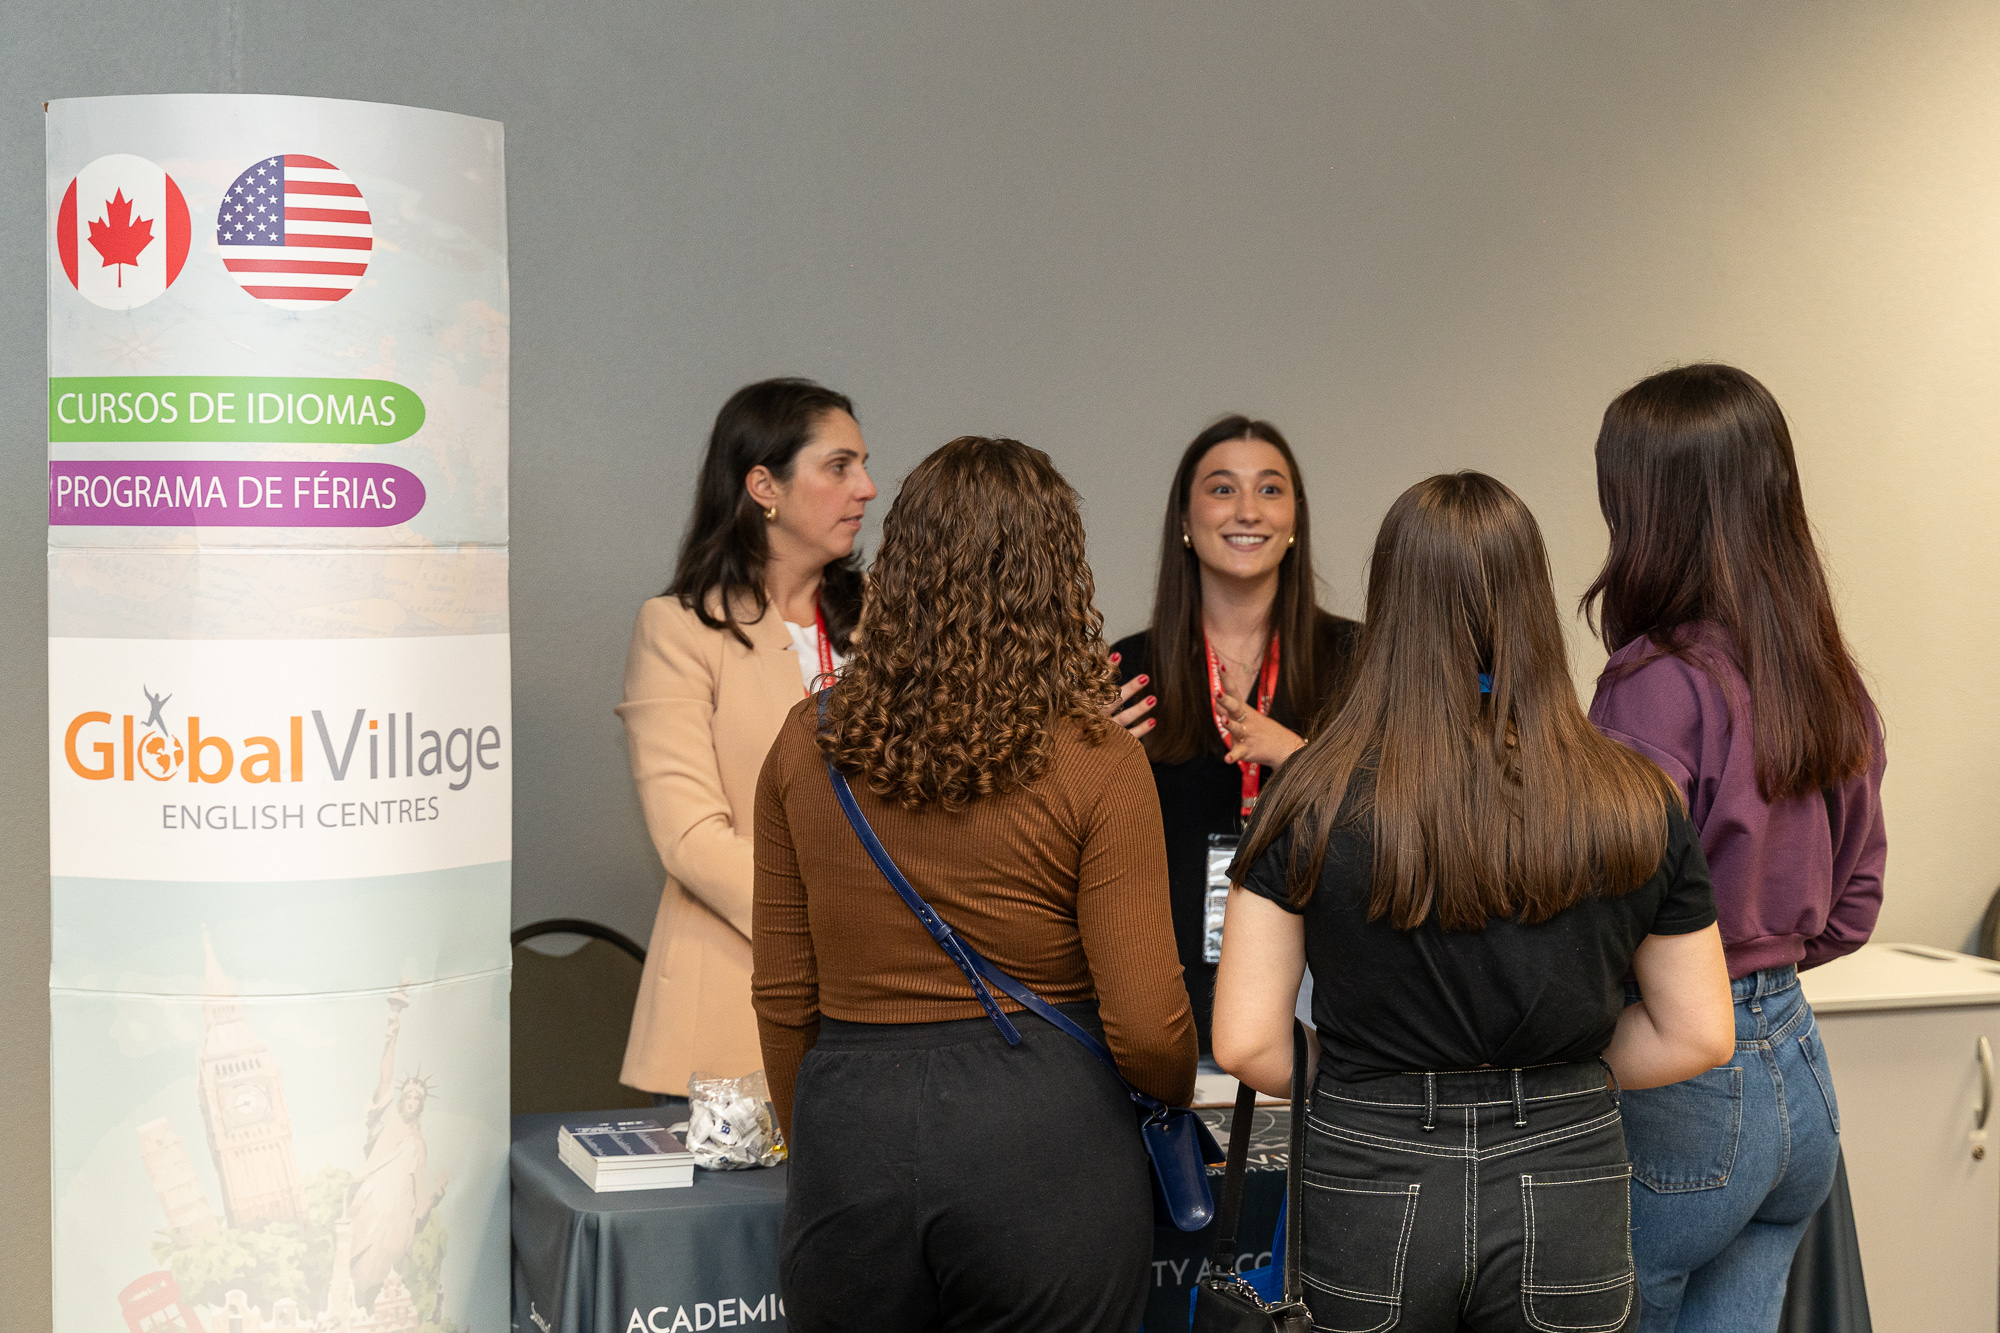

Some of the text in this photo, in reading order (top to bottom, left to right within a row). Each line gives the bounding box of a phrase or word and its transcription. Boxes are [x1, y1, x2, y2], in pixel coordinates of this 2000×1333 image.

[57, 391, 397, 427] CURSOS DE IDIOMAS
[57, 470, 397, 510] PROGRAMA DE FÉRIAS
[311, 708, 501, 791] Village
[162, 796, 440, 830] ENGLISH CENTRES
[626, 1293, 787, 1333] ACADEMI
